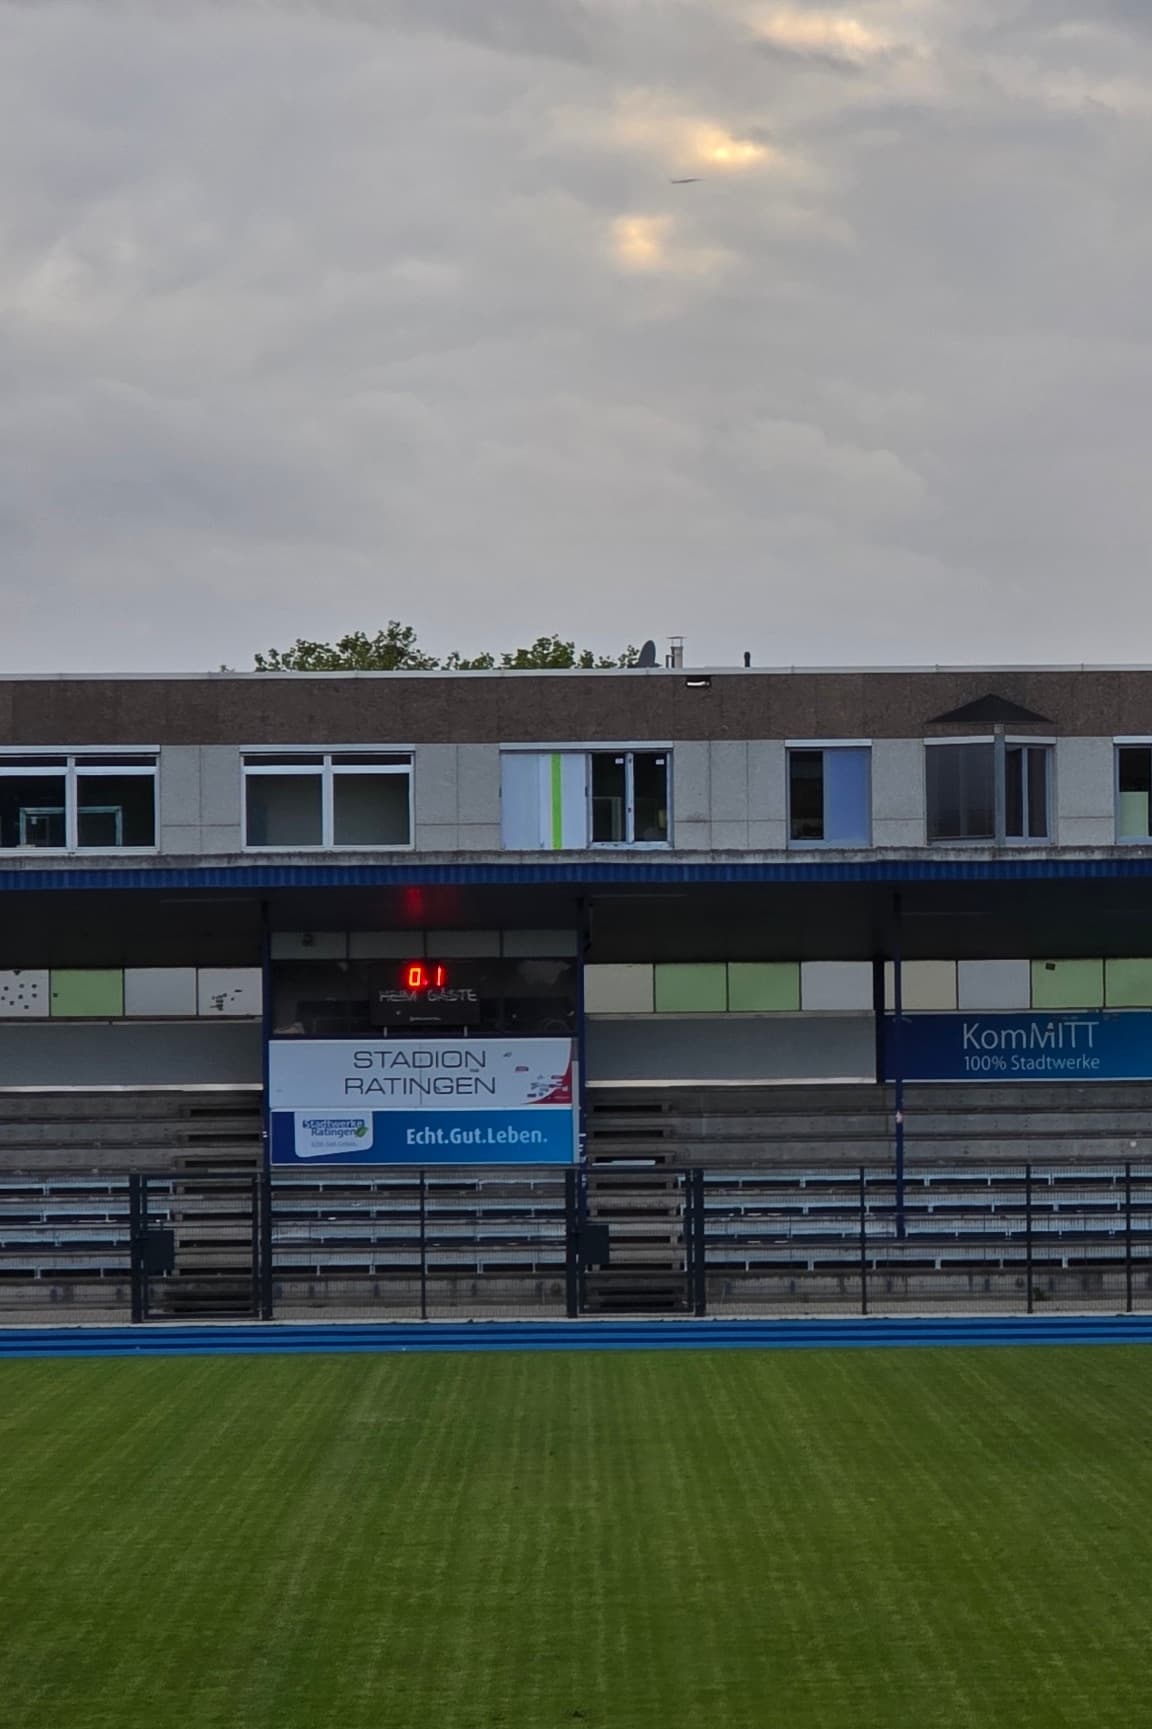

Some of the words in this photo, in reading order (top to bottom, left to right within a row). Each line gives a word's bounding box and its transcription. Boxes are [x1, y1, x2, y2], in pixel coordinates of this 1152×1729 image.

[962, 1021, 1099, 1050] KomMITT
[352, 1050, 486, 1069] STADION
[964, 1055, 1007, 1071] 100%
[1010, 1053, 1100, 1071] Stadtwerke
[344, 1076, 496, 1095] RATINGEN
[311, 1127, 355, 1138] Ratingen
